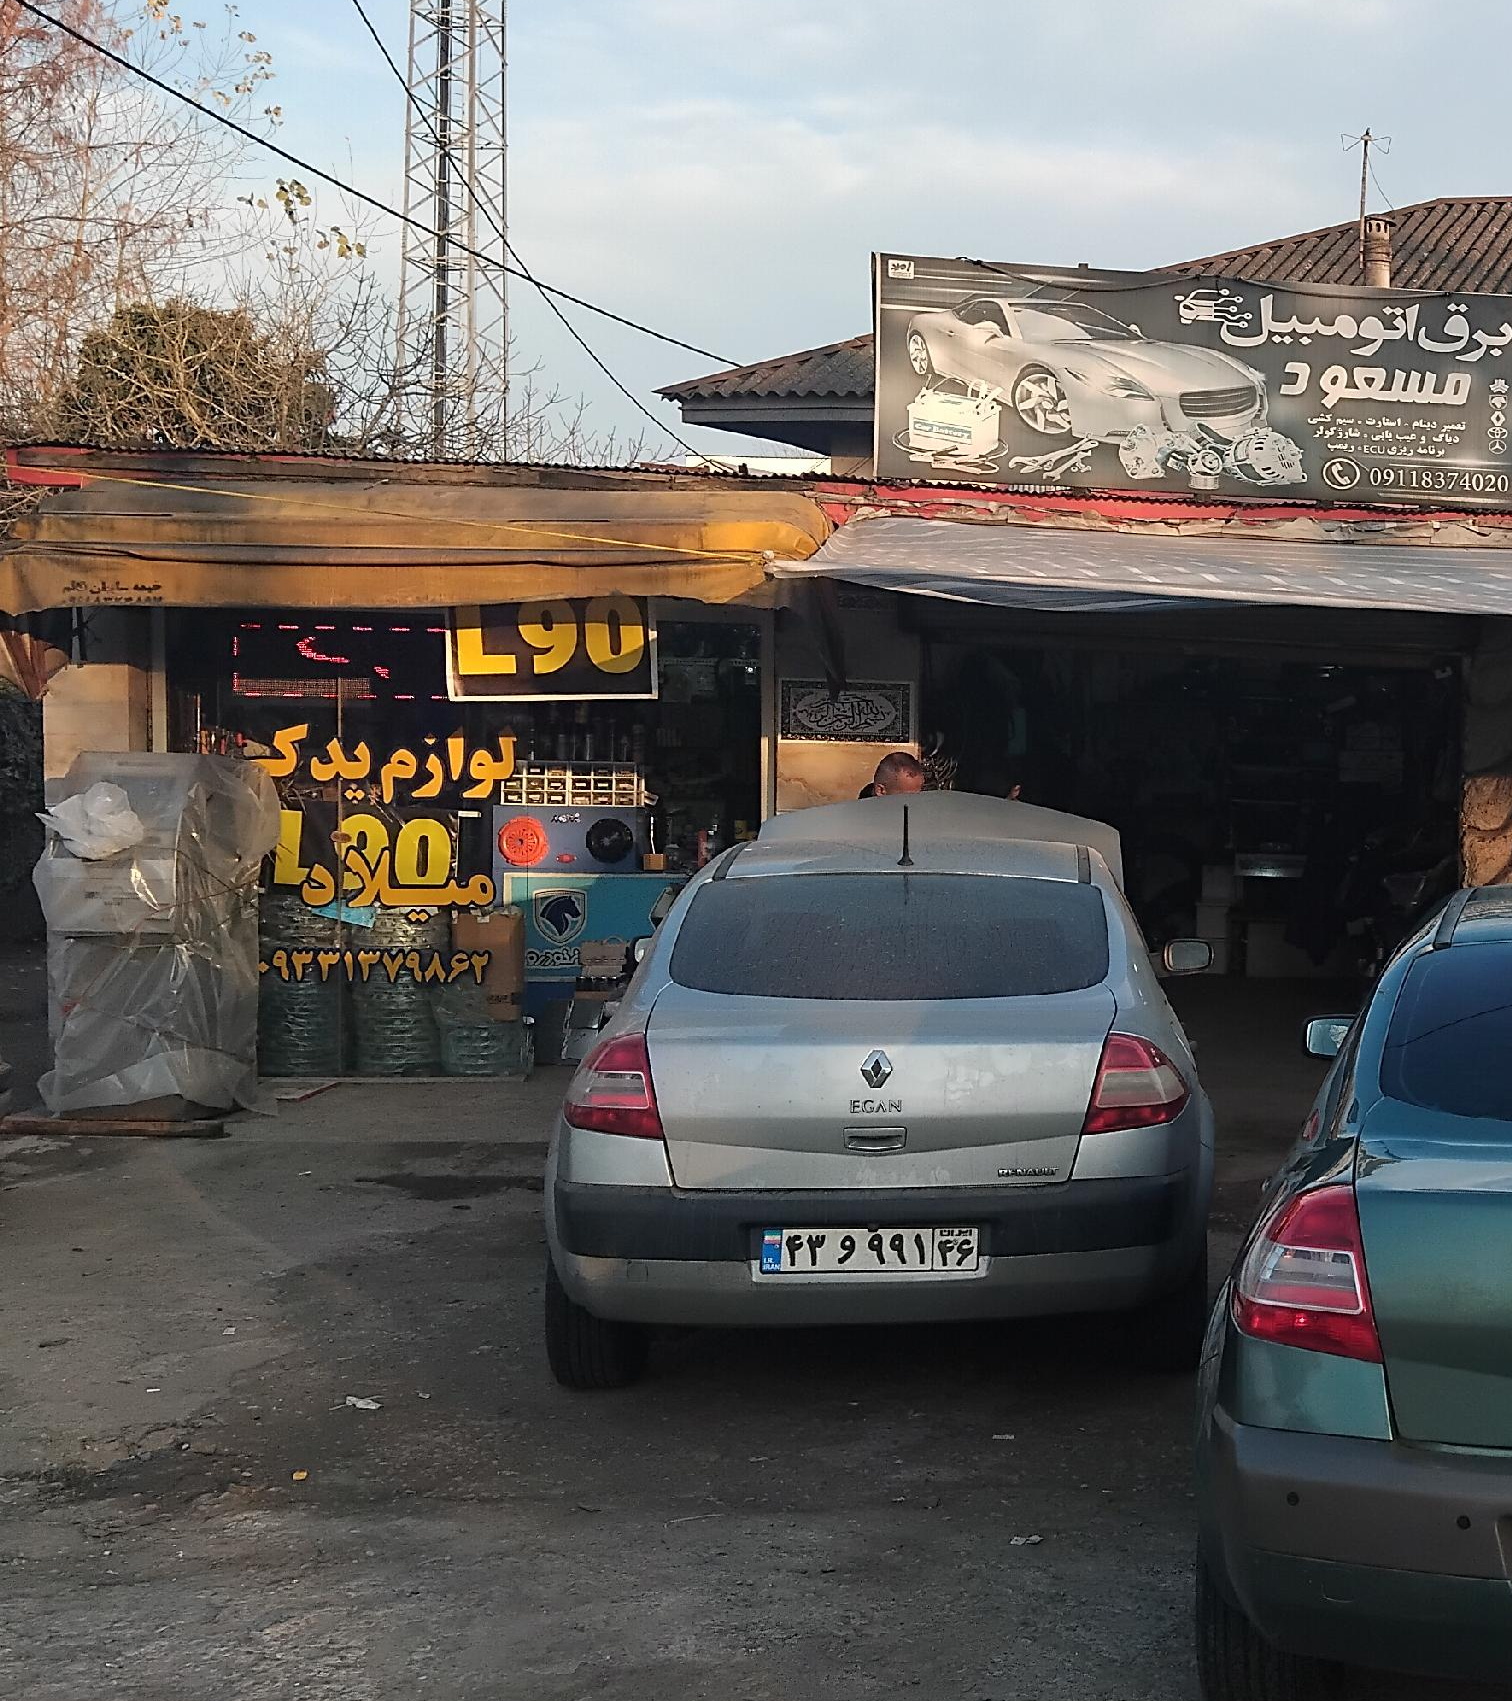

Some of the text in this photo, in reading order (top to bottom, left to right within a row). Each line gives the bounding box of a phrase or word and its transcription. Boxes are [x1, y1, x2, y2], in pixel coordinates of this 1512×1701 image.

[1220, 294, 1512, 362] برق اتومبیل
[1280, 361, 1472, 410] مسعود
[1307, 413, 1467, 432] تعمیر دینام استارت سیم کشی
[1371, 430, 1393, 441] یابی
[1395, 433, 1417, 442] عیب
[1419, 435, 1426, 444] و
[1363, 445, 1385, 454] ECU
[1387, 445, 1414, 456] ریزی
[1416, 445, 1445, 458] برنامه
[1369, 467, 1509, 492] 09118374020
[456, 597, 646, 676] L90
[381, 726, 518, 804] لوازم
[301, 847, 495, 923] میلاد
[258, 949, 491, 984] ۰۹۳۳۱۳۷۹۸۶۲
[850, 1099, 903, 1114] EGAN
[998, 1166, 1060, 1178] RENAULT
[939, 1229, 974, 1237] ایران
[785, 1234, 826, 1268] ۴۳
[867, 1233, 927, 1266] ۹۹۱
[937, 1238, 975, 1268] ۴۶
